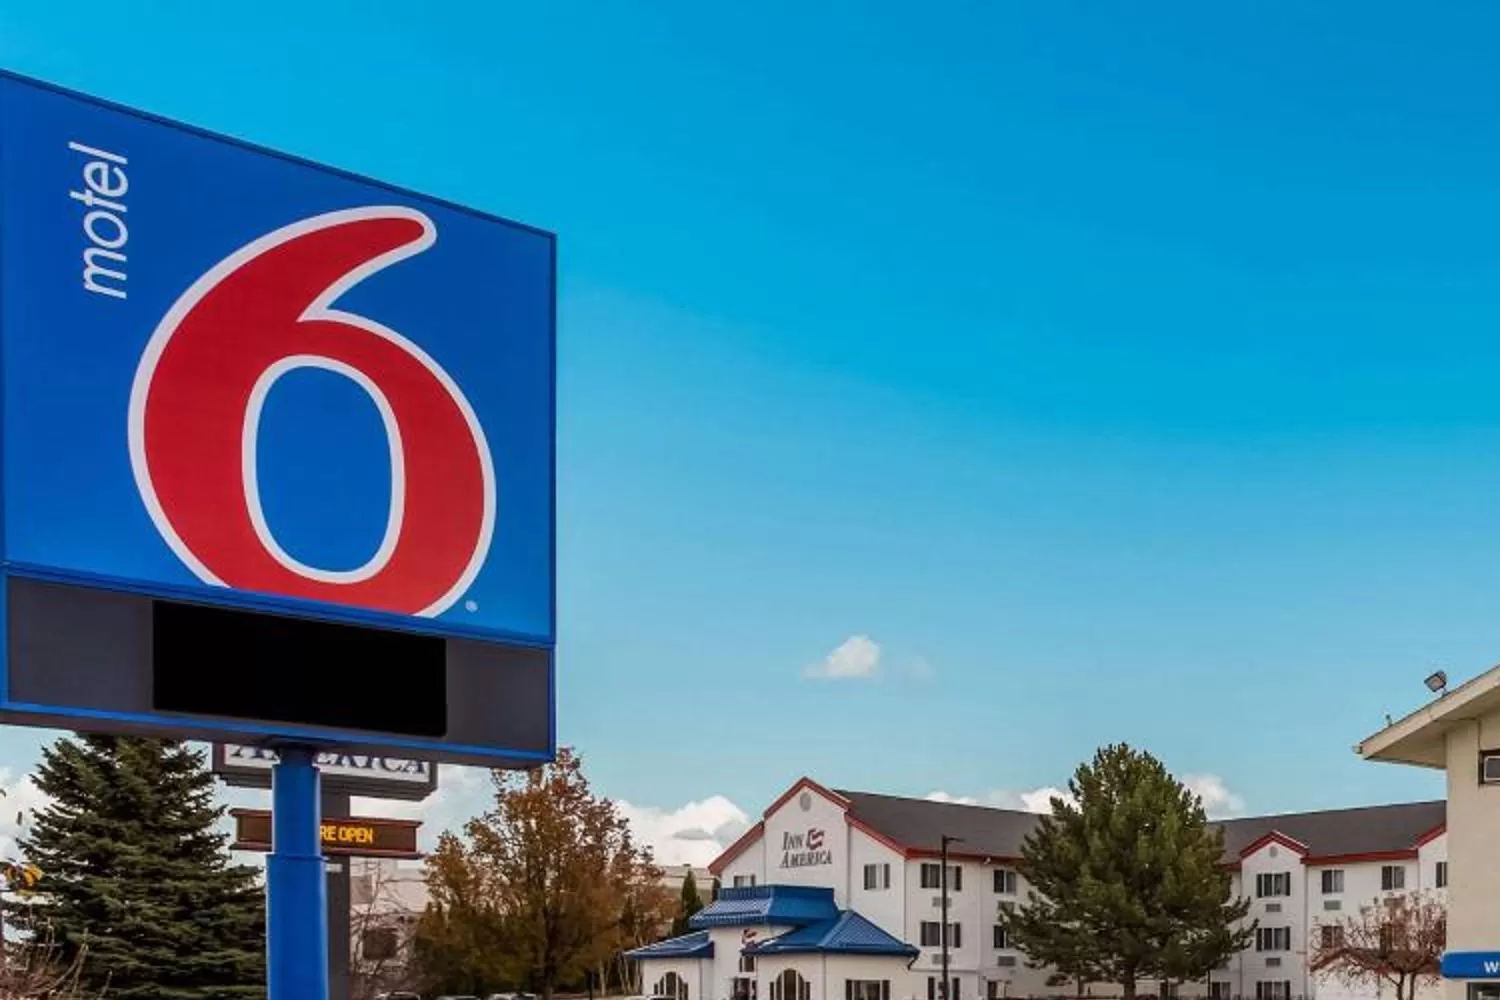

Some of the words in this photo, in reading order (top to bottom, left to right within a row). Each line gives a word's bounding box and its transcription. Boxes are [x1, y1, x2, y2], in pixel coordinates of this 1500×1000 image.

[69, 141, 128, 299] motel
[128, 204, 497, 619] 6
[319, 825, 337, 841] RE
[338, 826, 374, 844] OPEN
[781, 831, 804, 850] INN
[779, 849, 833, 869] AMERICA
